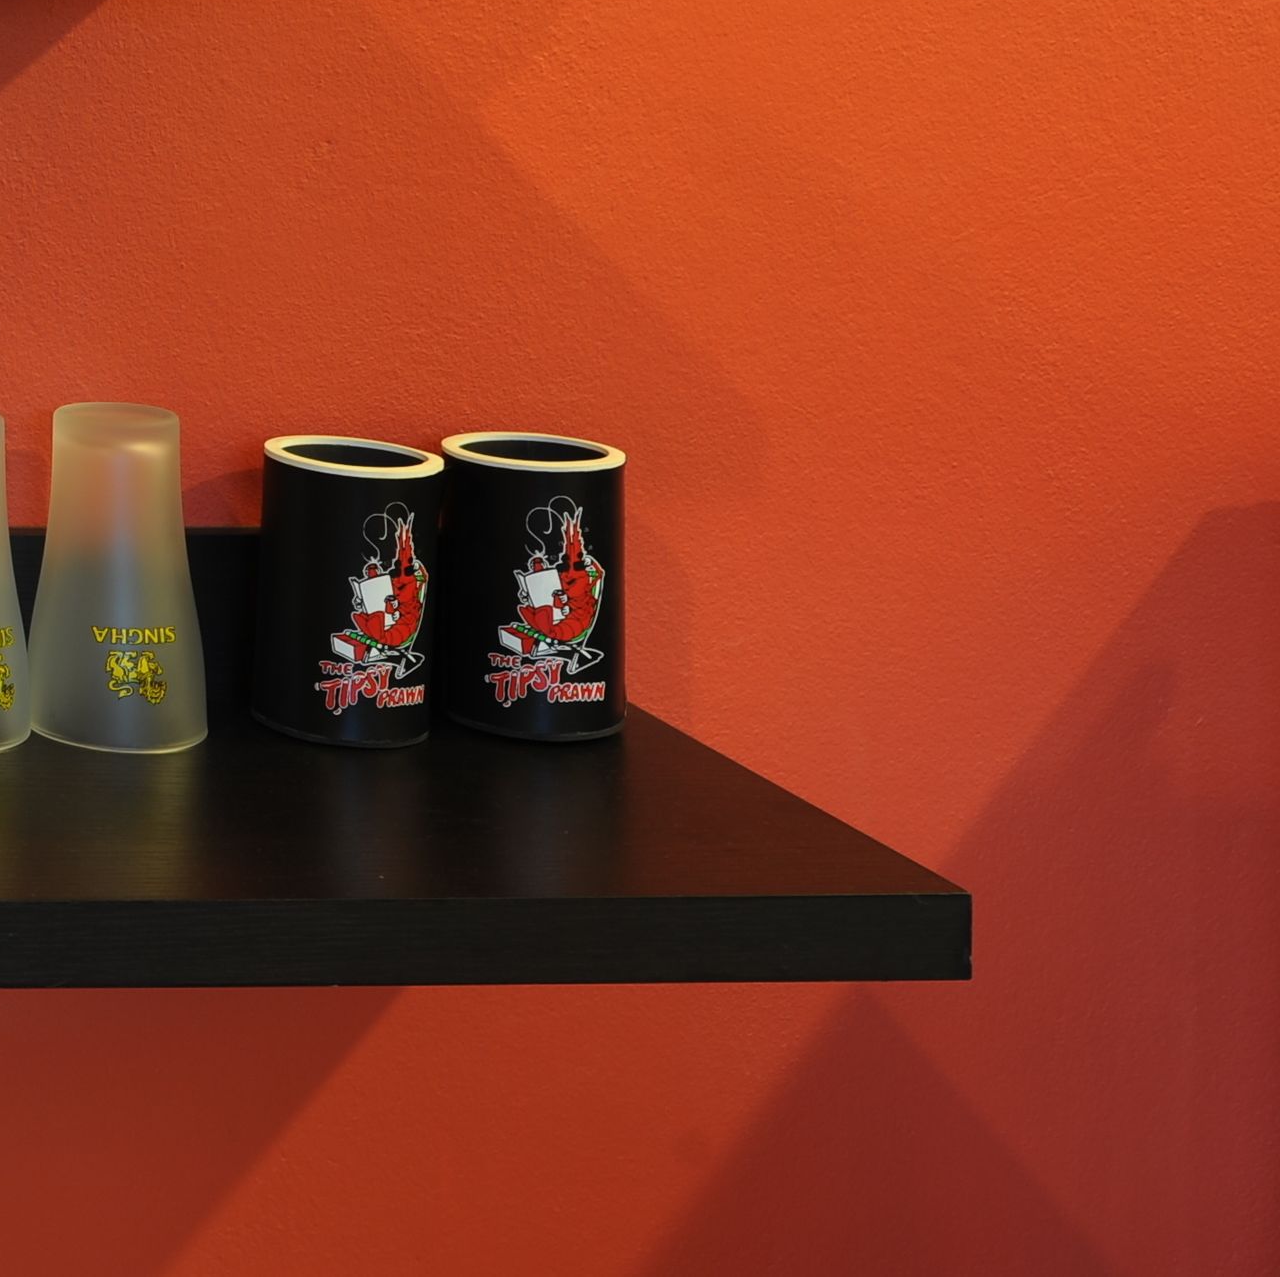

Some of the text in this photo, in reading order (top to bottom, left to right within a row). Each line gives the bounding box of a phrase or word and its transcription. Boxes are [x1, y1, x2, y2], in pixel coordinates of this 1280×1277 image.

[90, 624, 177, 646] SINGHA
[319, 660, 355, 677] THE
[487, 652, 522, 669] THE
[320, 665, 393, 710] TIPSY
[489, 658, 564, 703] TIPSY
[376, 684, 426, 708] PRAWN
[546, 681, 606, 704] PRAWN
